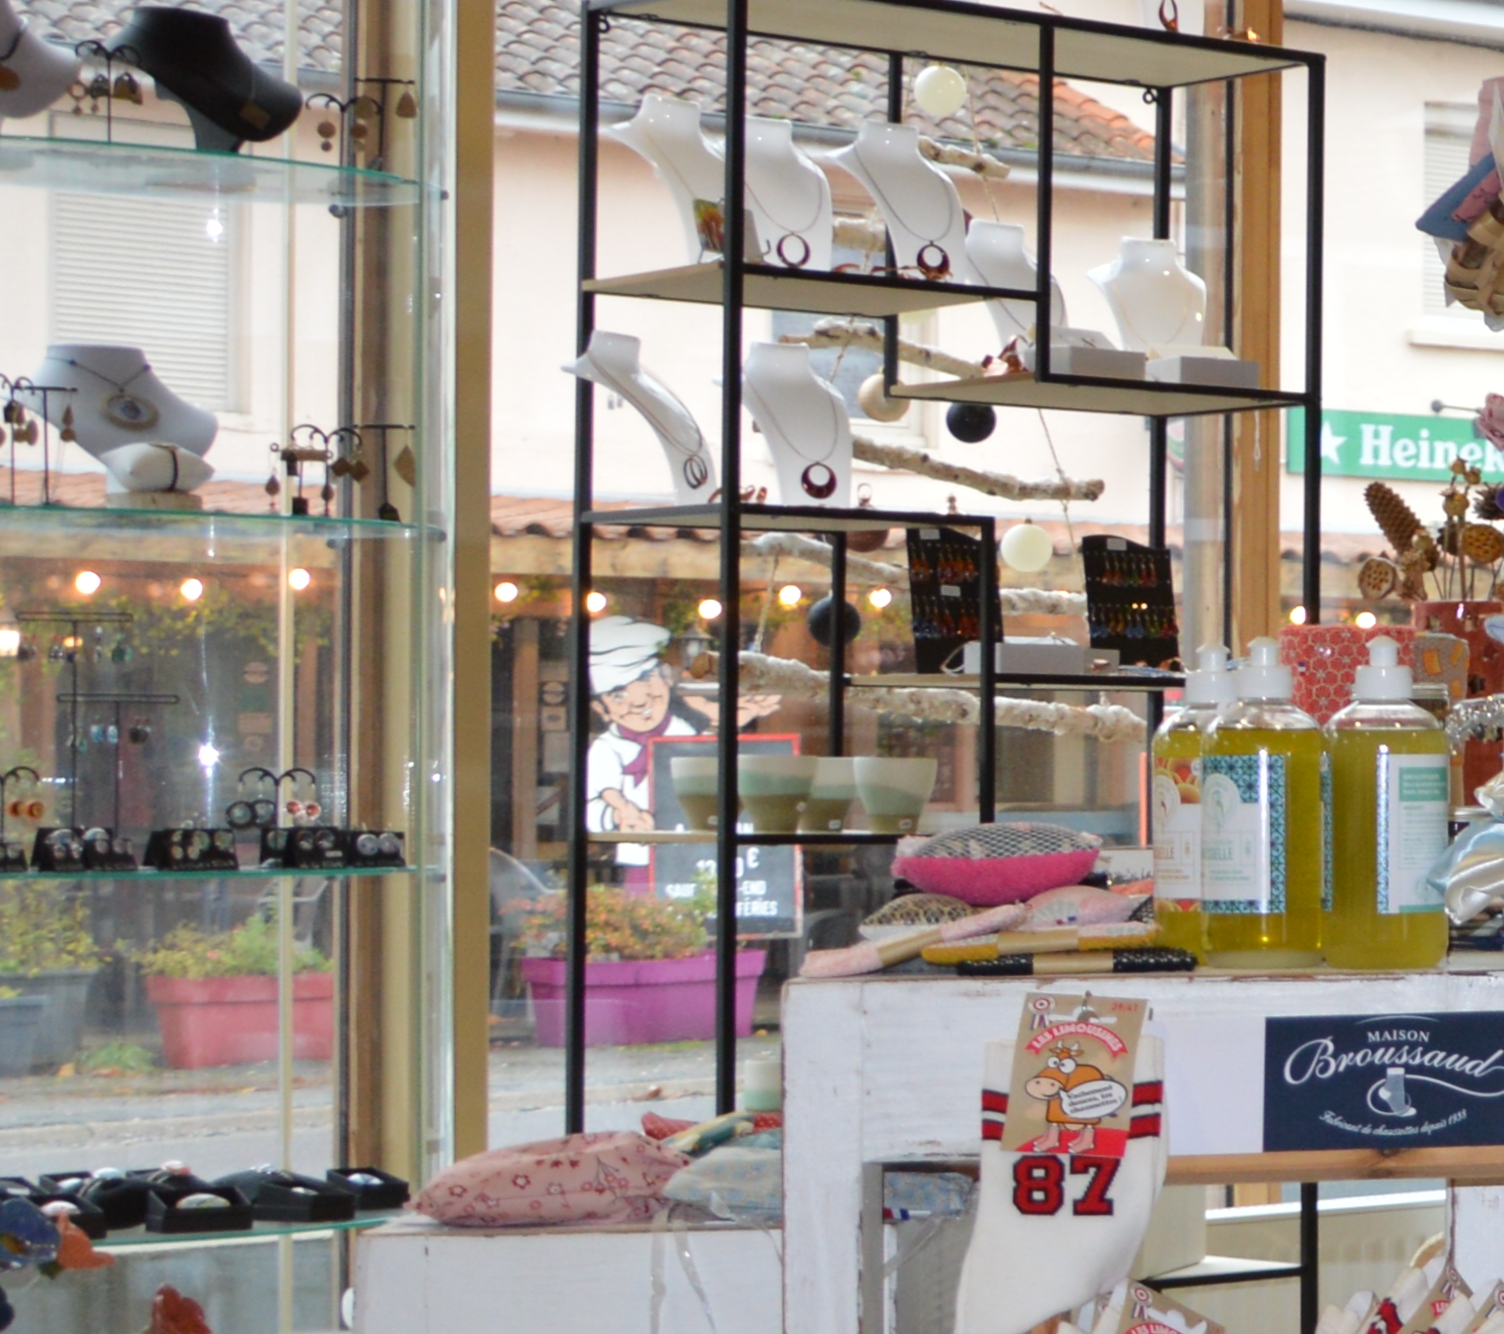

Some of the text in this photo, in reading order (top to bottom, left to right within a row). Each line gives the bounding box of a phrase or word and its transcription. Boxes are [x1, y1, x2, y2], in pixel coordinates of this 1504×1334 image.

[665, 882, 698, 898] SAUF
[1031, 1022, 1124, 1053] LES LIMOUSINES
[1366, 1028, 1431, 1044] MAISON
[1012, 1154, 1121, 1216] 87
